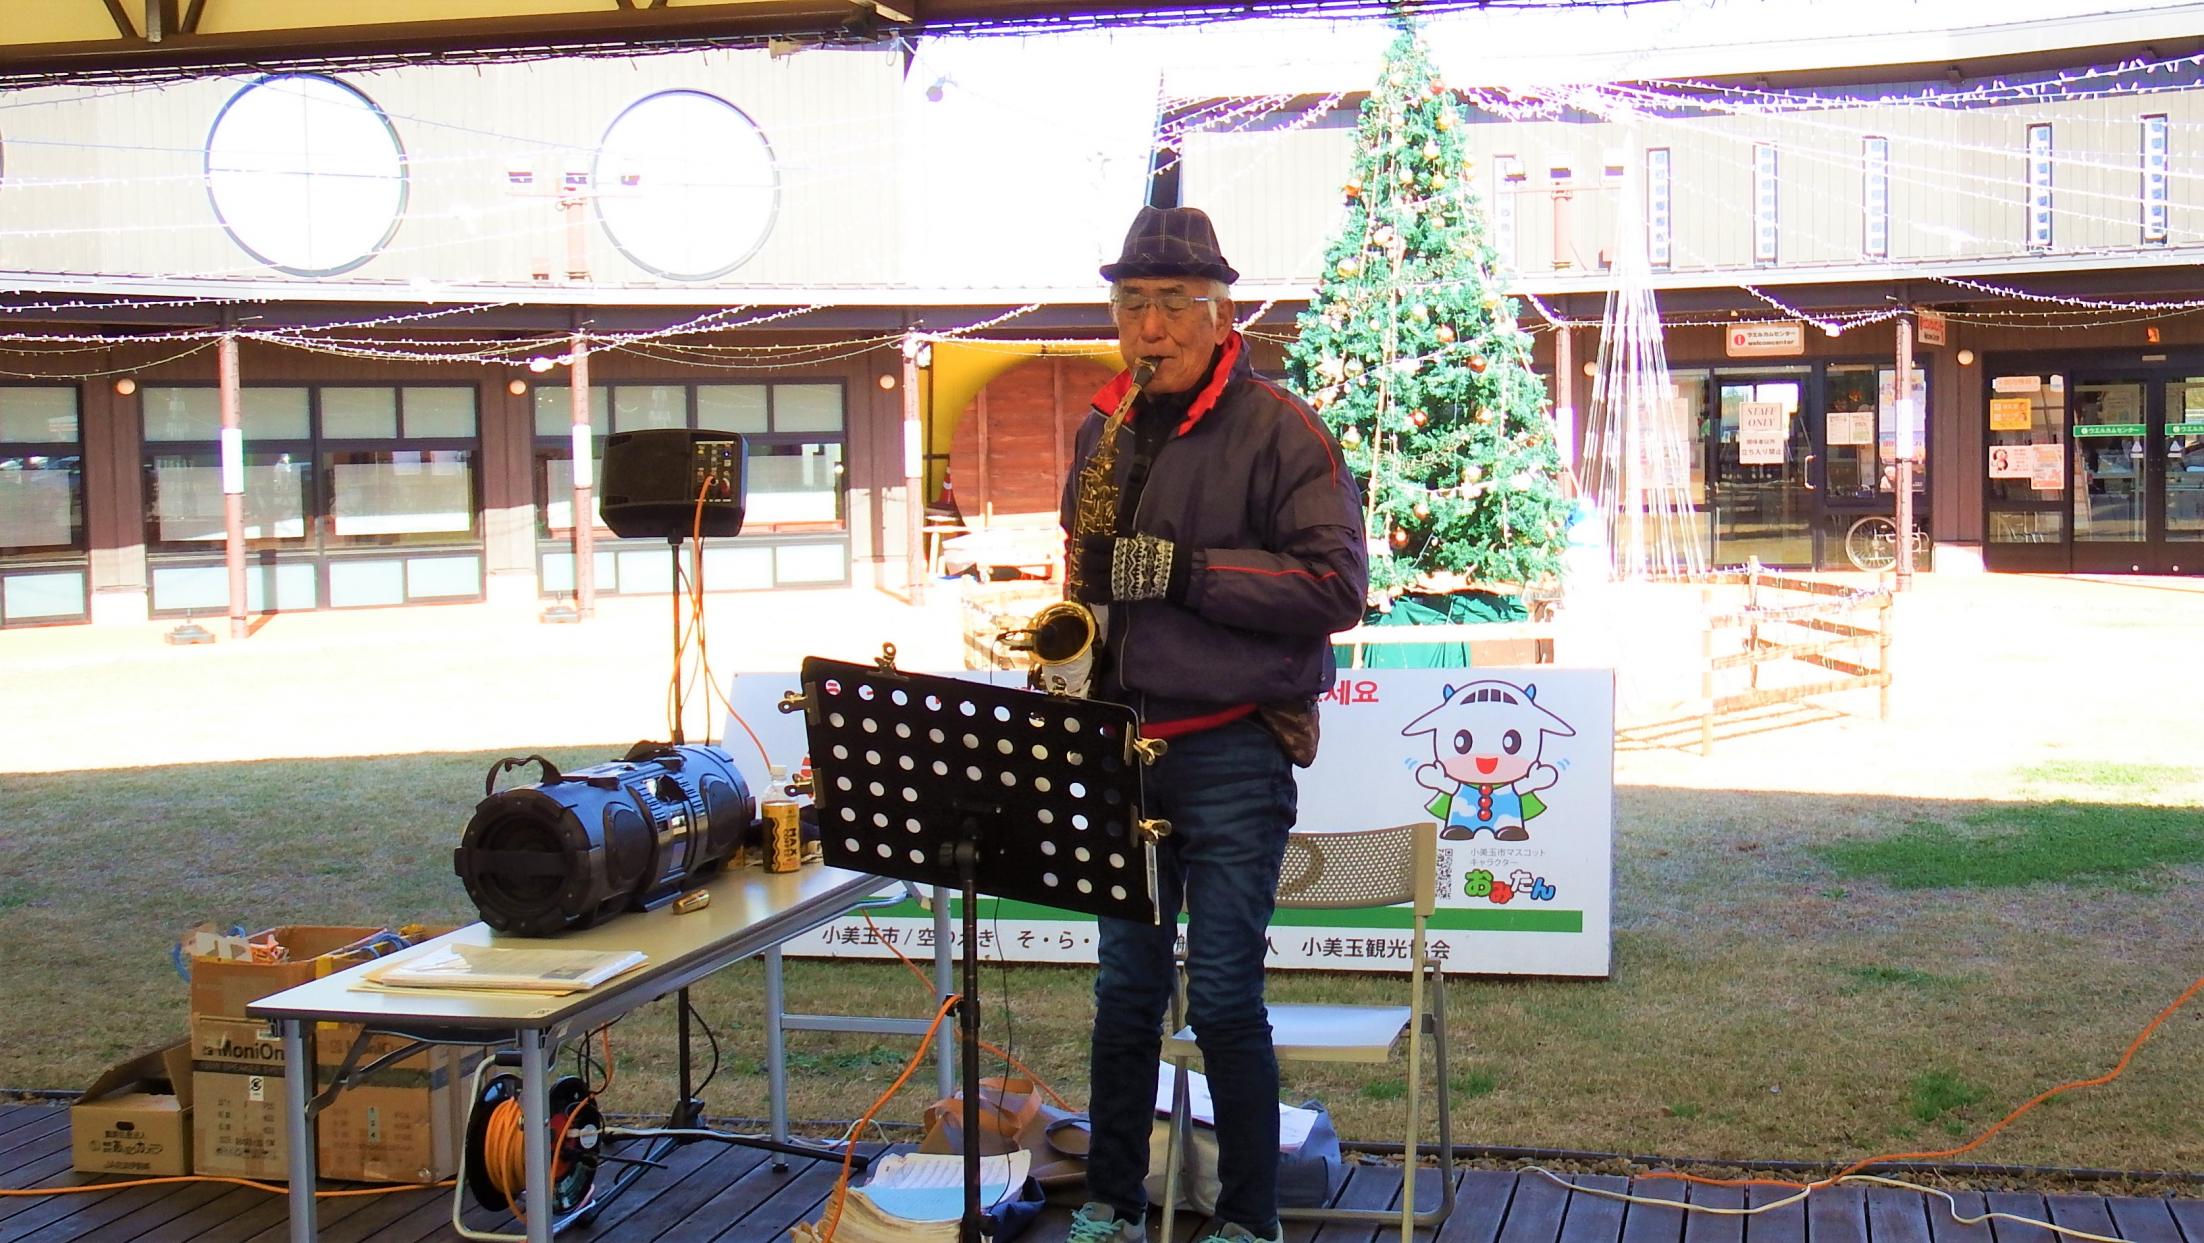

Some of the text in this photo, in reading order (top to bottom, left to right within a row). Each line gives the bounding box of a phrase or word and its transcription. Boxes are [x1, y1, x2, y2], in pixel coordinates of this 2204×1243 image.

[1747, 407, 1775, 416] STAFF
[1748, 418, 1775, 427] ONLY
[1742, 447, 1782, 456] 立ち入り禁止
[1319, 679, 1380, 706] 세요
[788, 827, 797, 856] MAX
[1470, 847, 1547, 857] 小美玉市マスコット
[1470, 858, 1519, 867] キャラクター
[1464, 868, 1556, 905] おみたん
